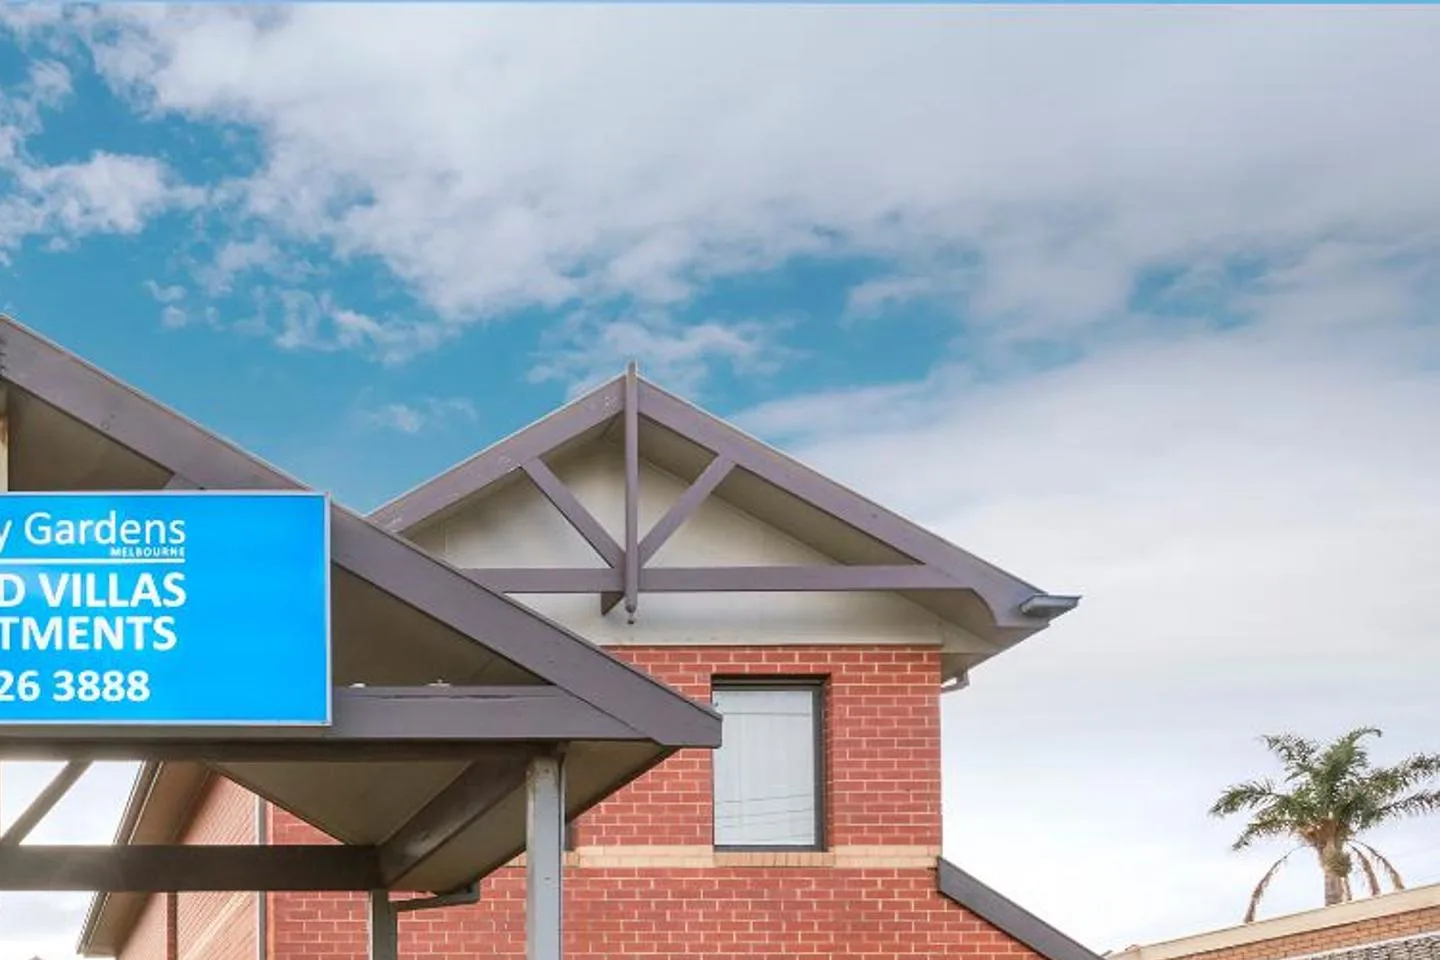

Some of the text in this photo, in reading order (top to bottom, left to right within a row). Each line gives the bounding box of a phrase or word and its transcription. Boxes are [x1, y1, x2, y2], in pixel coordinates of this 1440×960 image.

[24, 510, 186, 546] Gardens
[110, 547, 185, 557] MELBOURNE
[38, 571, 187, 608] VILLAS
[52, 669, 151, 702] 3888
